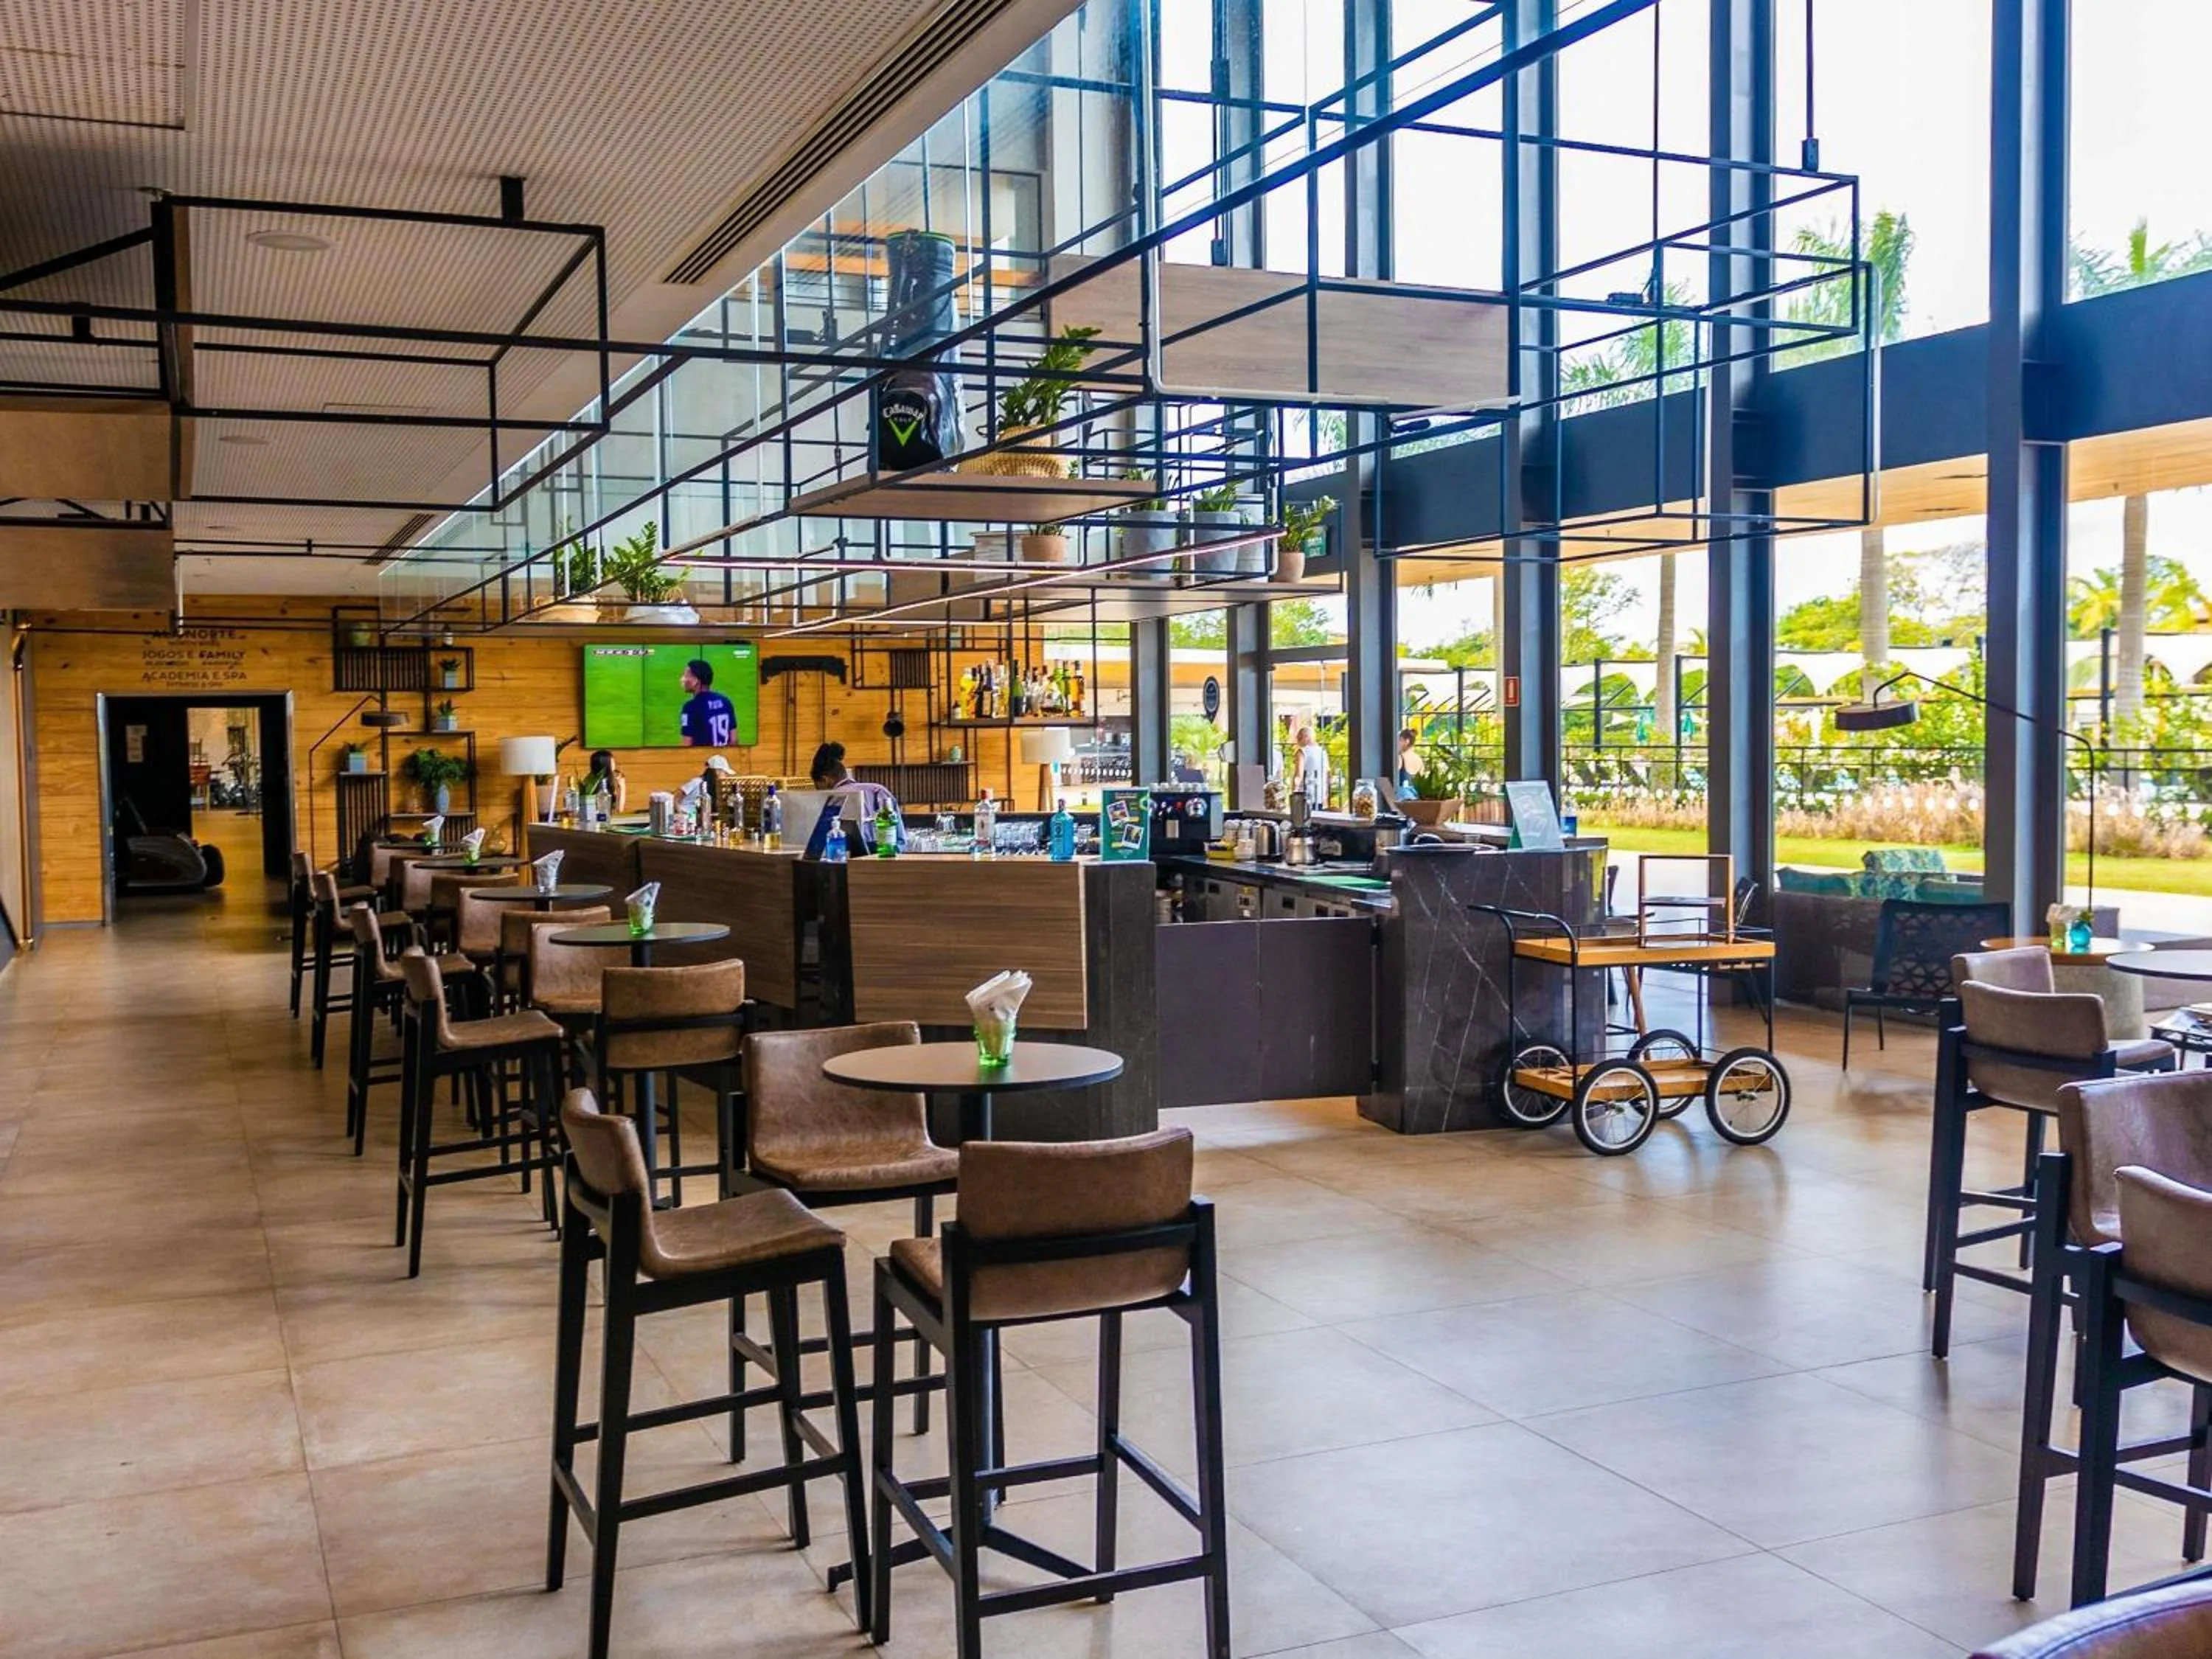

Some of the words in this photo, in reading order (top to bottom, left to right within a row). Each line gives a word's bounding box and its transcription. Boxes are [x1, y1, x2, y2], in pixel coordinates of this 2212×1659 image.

[142, 650, 184, 659] JOGOS
[198, 650, 246, 660] FAMILY
[142, 671, 209, 681] ACADEMIA
[212, 671, 219, 680] E
[223, 671, 248, 681] SPA
[709, 713, 729, 747] 19
